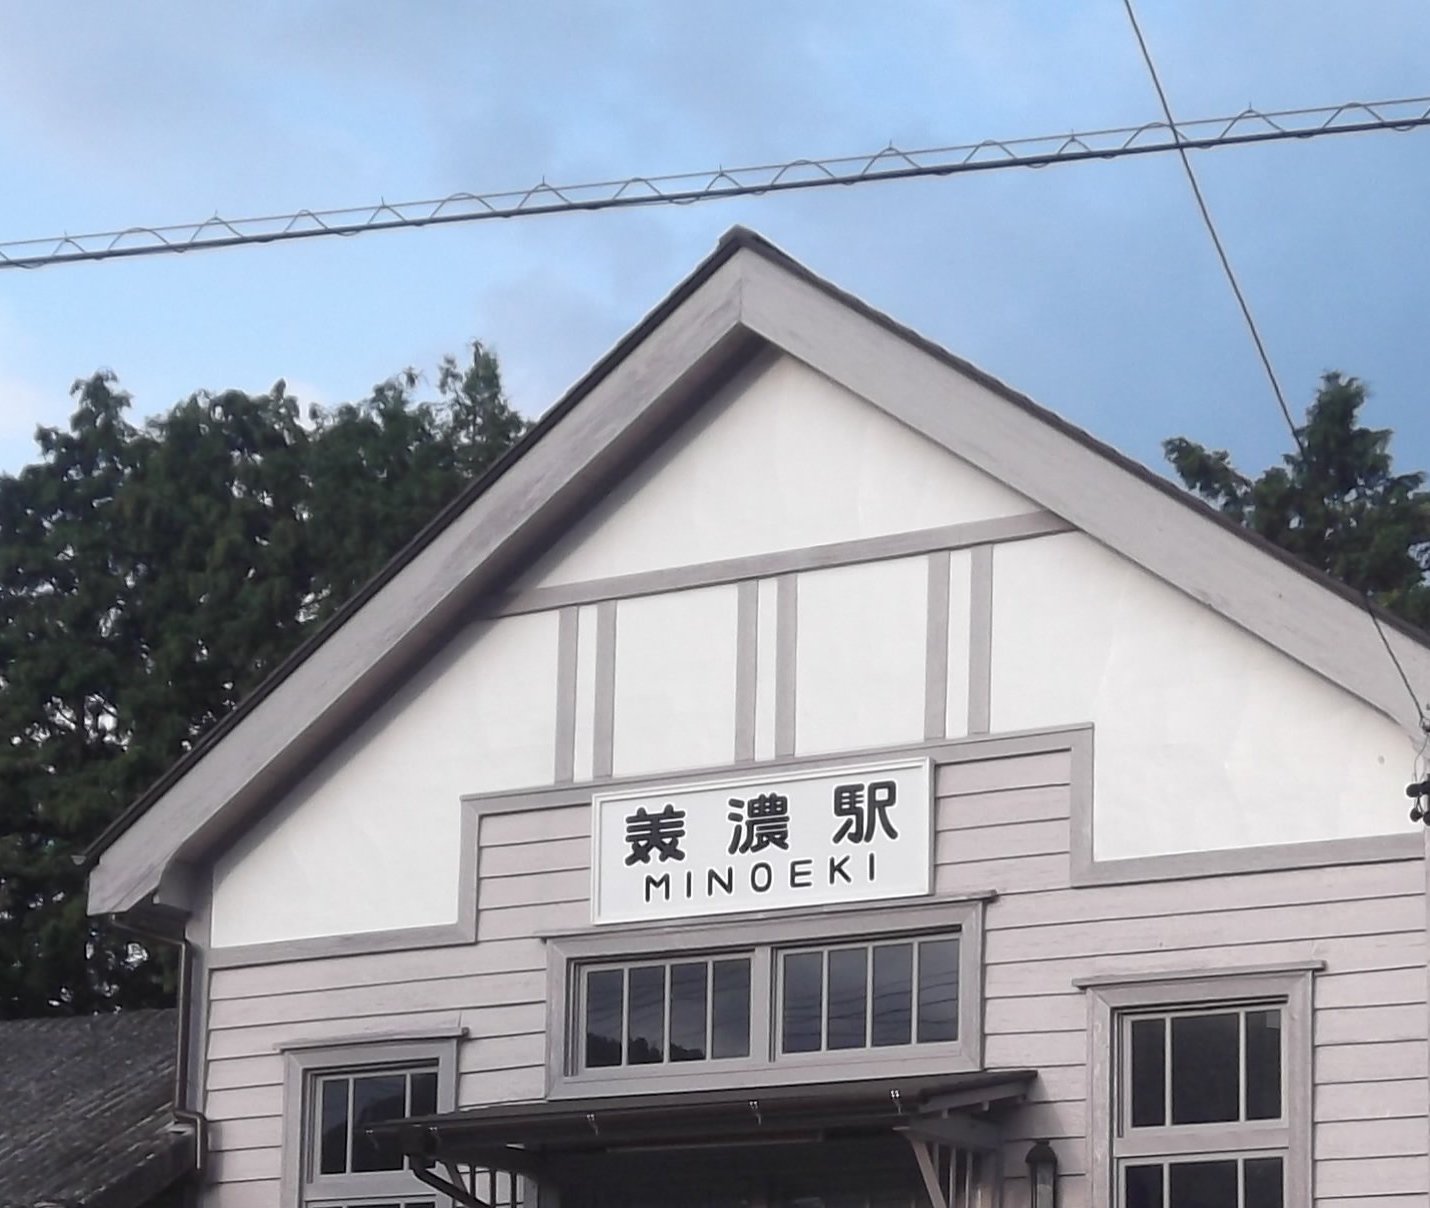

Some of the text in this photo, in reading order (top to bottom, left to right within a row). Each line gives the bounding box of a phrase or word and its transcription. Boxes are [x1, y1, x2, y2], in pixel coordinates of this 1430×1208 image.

[624, 780, 898, 867] 美濃駅
[644, 852, 877, 903] MINOEKI
